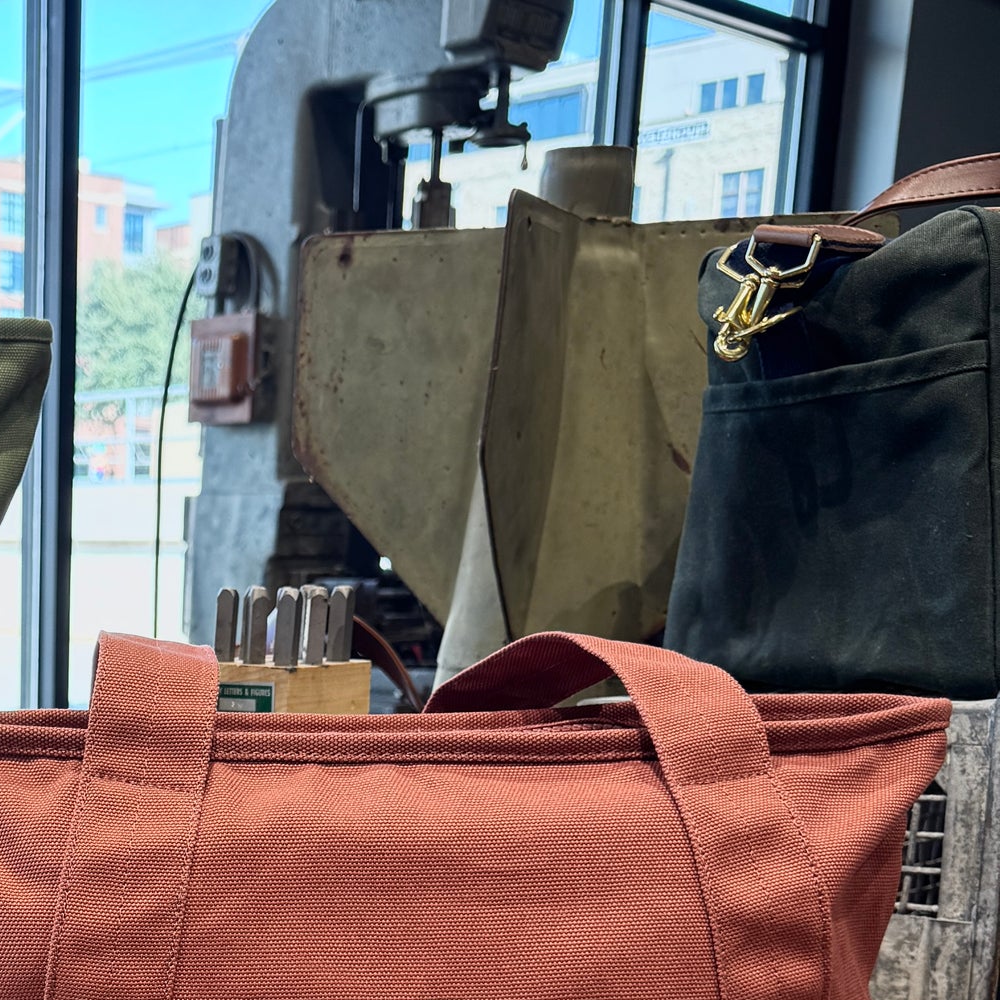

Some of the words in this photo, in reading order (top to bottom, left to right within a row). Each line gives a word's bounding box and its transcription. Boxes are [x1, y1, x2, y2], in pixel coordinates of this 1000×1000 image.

[223, 687, 243, 696] LETTERS
[244, 688, 249, 696] &
[250, 688, 271, 697] FIGURES
